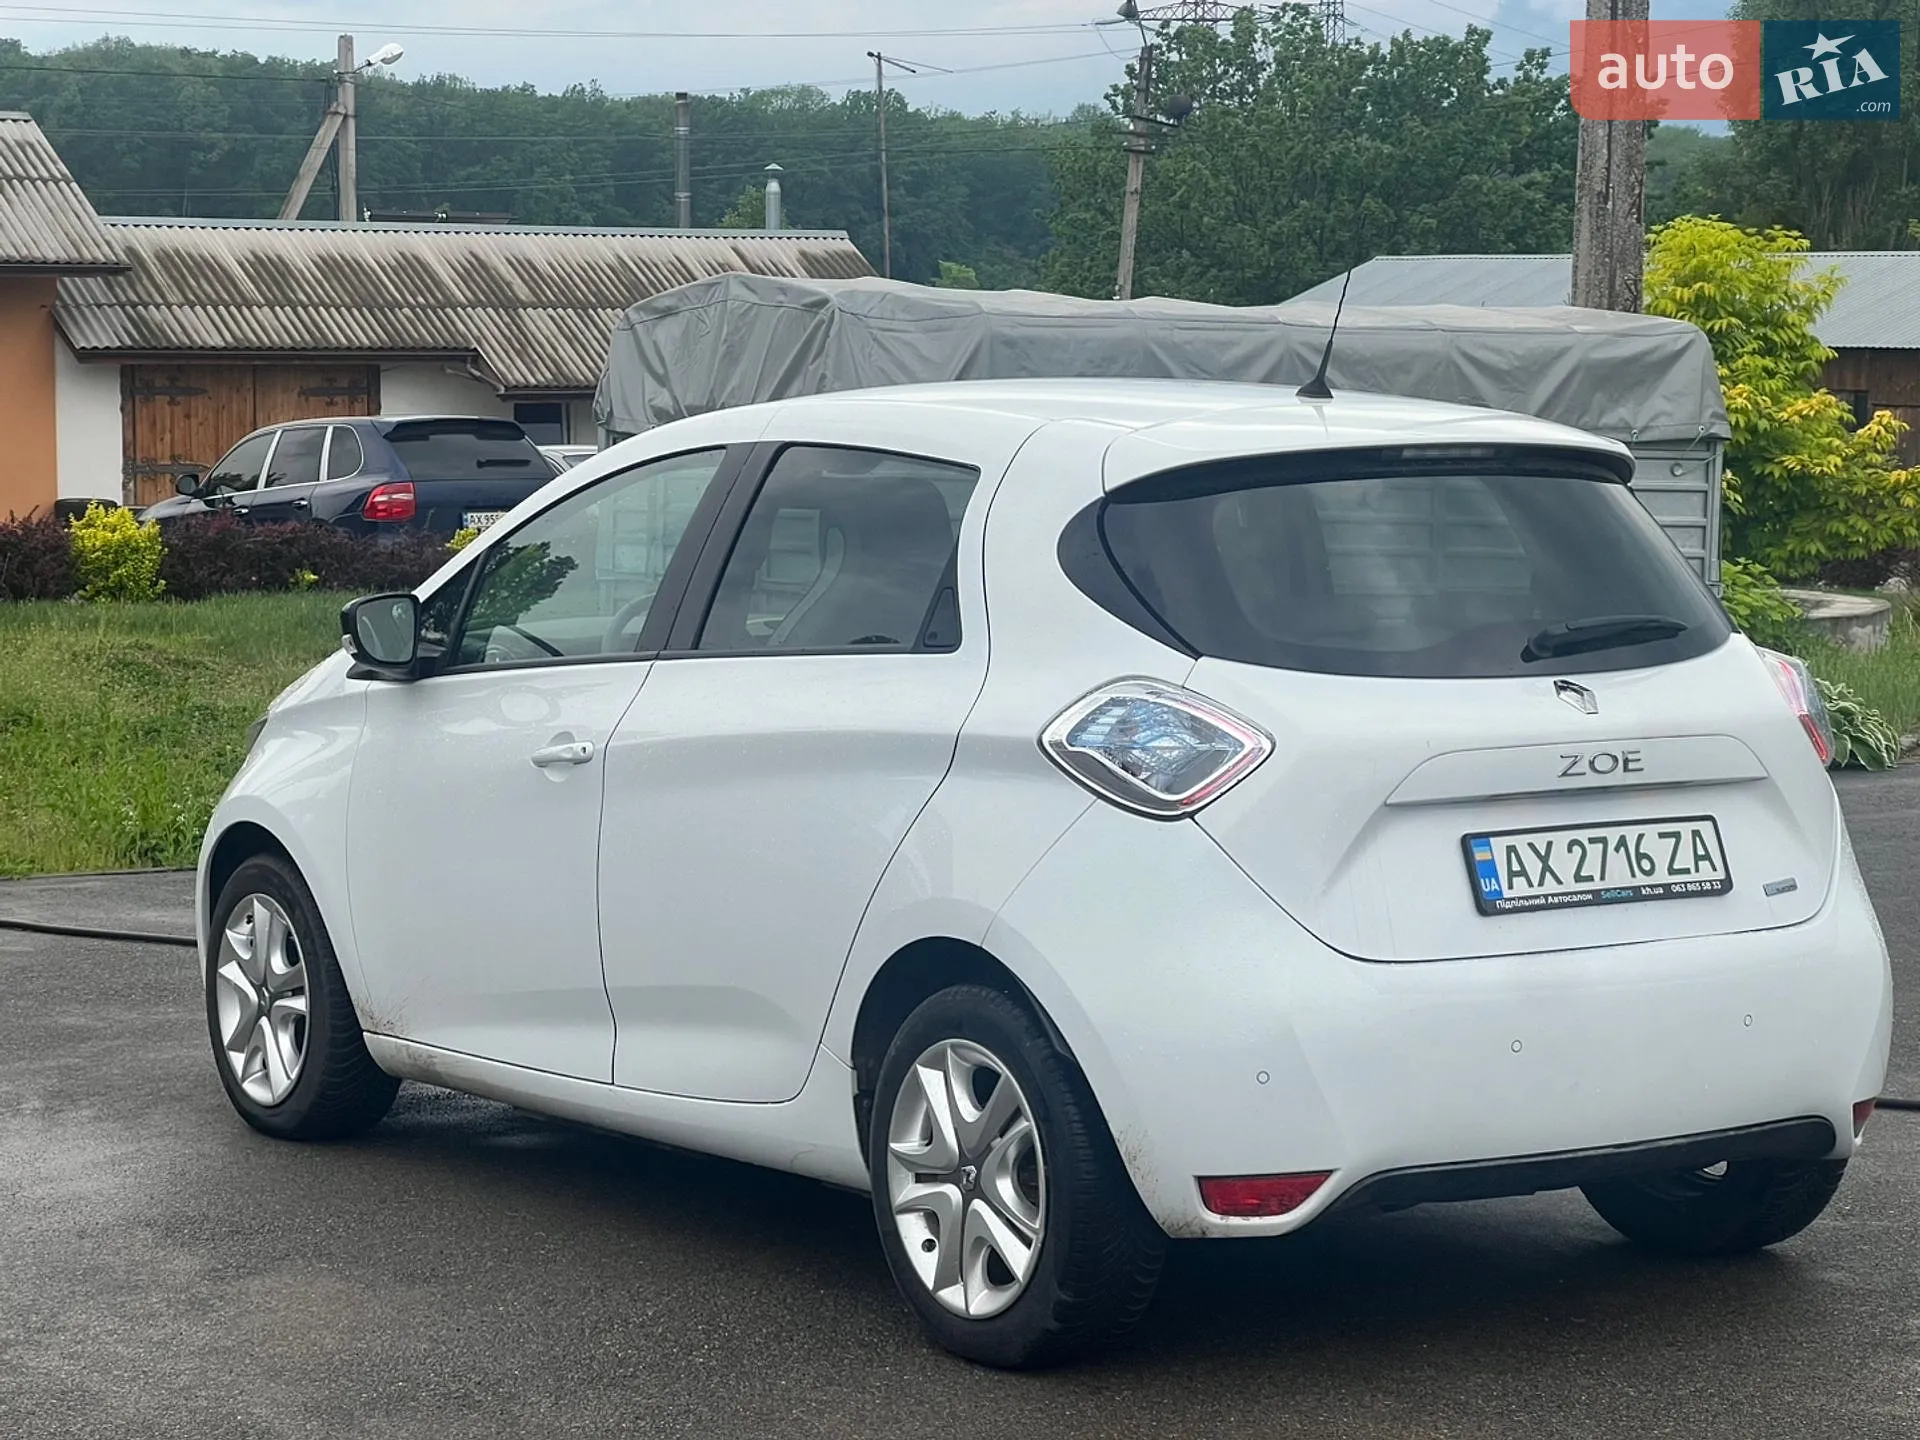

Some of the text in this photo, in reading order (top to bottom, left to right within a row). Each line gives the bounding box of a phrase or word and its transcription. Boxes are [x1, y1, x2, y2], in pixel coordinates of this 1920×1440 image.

[1557, 750, 1645, 778] ZOE
[1505, 829, 1718, 890] AX 2716 ZA
[1480, 878, 1500, 892] UA
[1496, 897, 1546, 909] Підпільний
[1547, 893, 1593, 905] Автосалон
